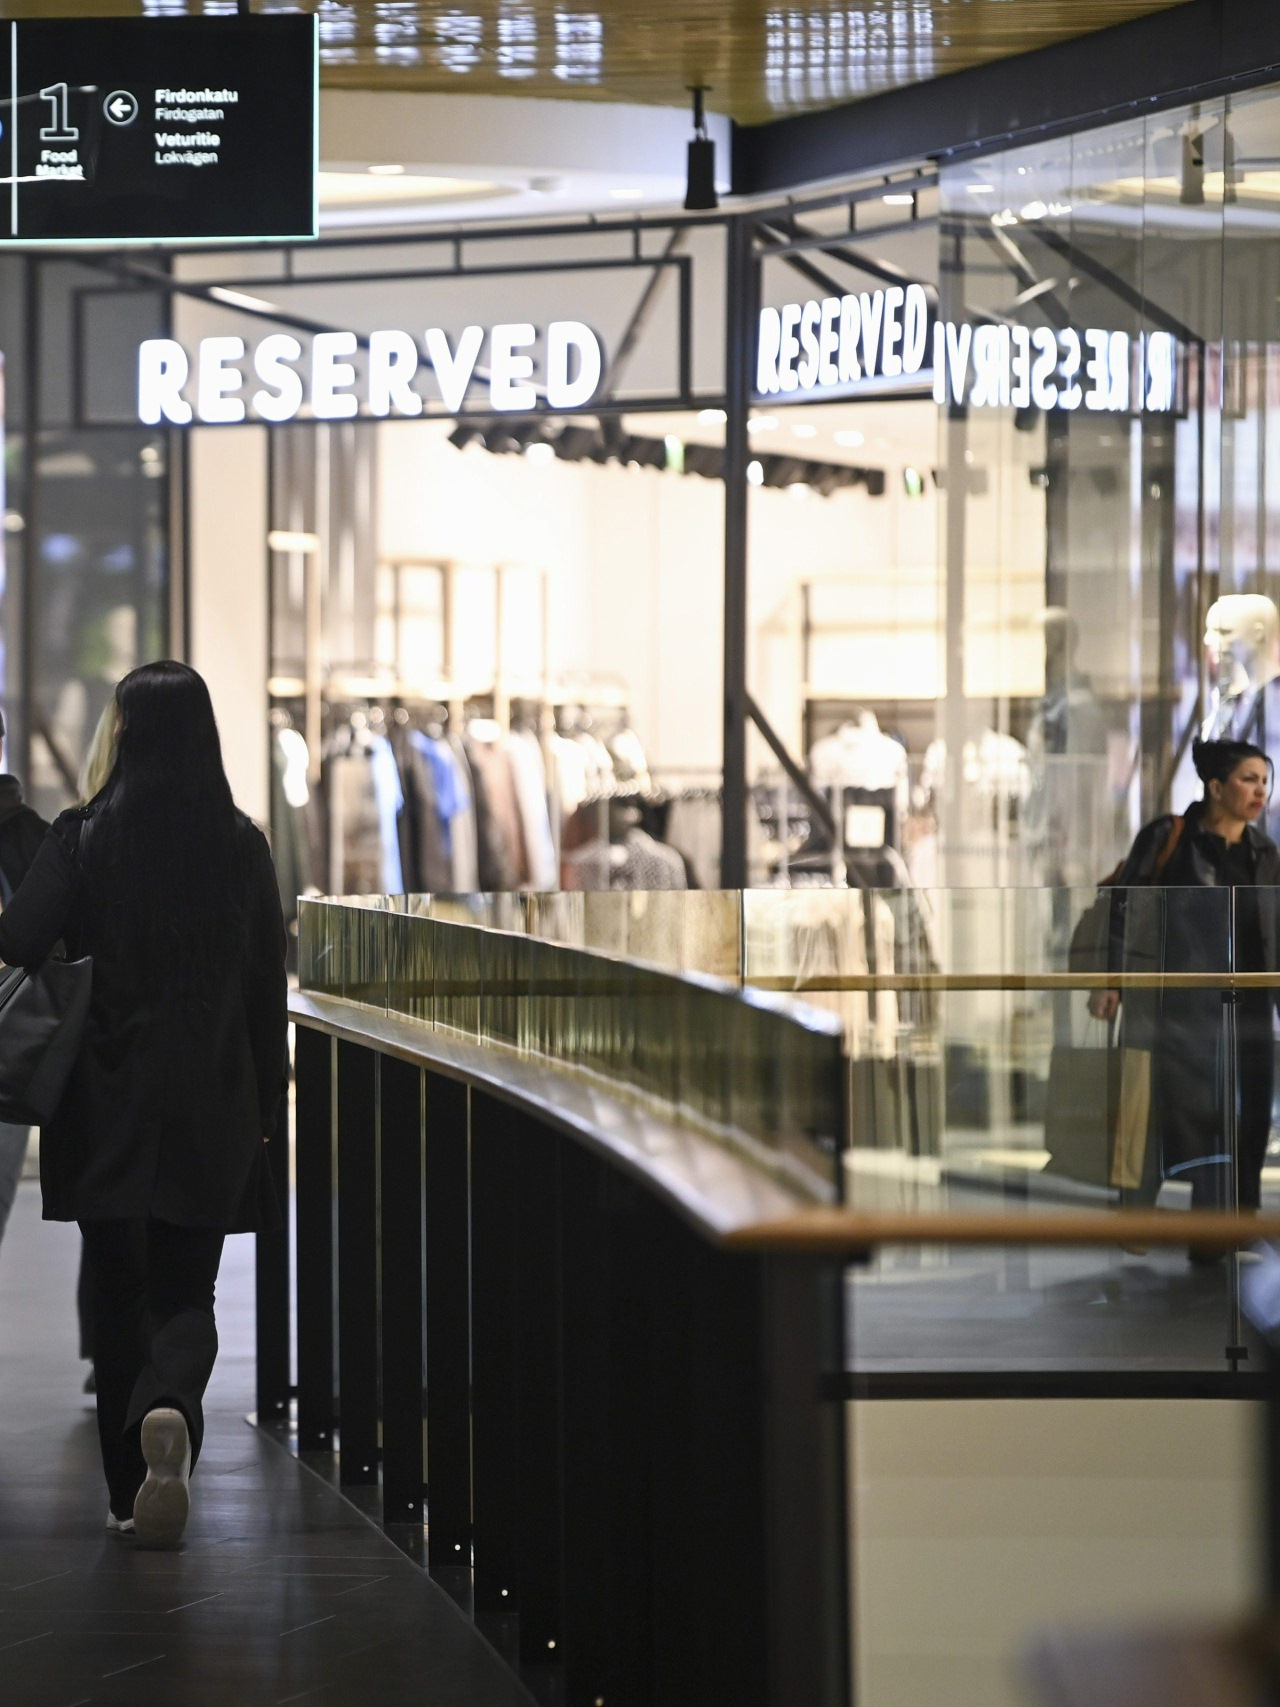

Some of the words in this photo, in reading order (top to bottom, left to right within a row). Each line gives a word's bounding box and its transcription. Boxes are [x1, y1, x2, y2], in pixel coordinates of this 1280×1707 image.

[155, 88, 238, 103] Firdonkatu
[39, 82, 79, 141] 1
[155, 107, 224, 123] Firdogatan
[154, 131, 220, 147] Veturitie
[41, 149, 78, 163] Food
[757, 283, 927, 394] RESERVED
[138, 320, 602, 425] RESERVED
